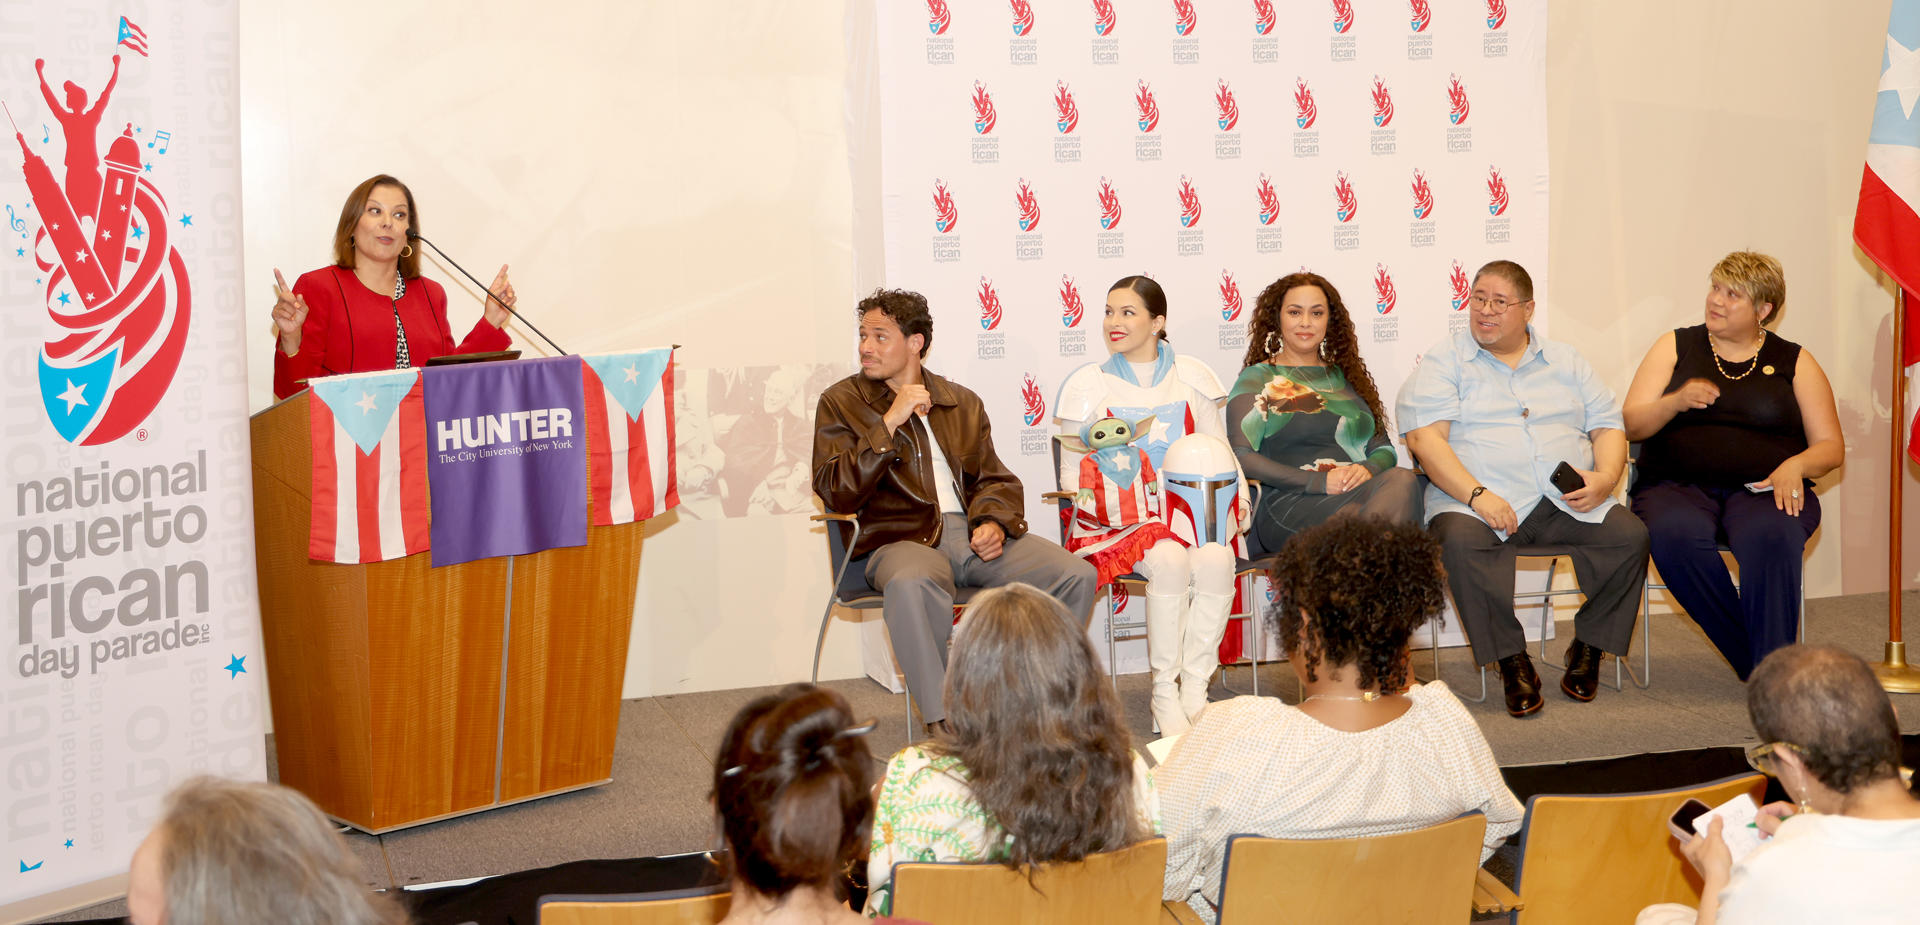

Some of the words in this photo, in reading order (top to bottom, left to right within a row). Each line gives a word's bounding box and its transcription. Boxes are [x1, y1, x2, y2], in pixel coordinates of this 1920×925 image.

[1331, 48, 1356, 58] rican
[1408, 47, 1432, 56] rican
[1484, 44, 1508, 54] rican
[927, 50, 954, 61] rican
[1010, 51, 1037, 62] rican
[1092, 51, 1118, 61] rican
[1173, 51, 1199, 61] rican
[1253, 50, 1278, 60] rican
[197, 30, 234, 168] rican
[1294, 143, 1319, 154] rican
[1371, 142, 1396, 152] rican
[1447, 139, 1471, 149] rican
[972, 150, 999, 160] rican
[1054, 149, 1081, 159] rican
[1136, 147, 1161, 157] rican
[1215, 146, 1241, 156] rican
[1411, 234, 1435, 243] rican
[1486, 230, 1510, 240] rican
[1178, 242, 1203, 252] rican
[1256, 240, 1282, 250] rican
[1334, 237, 1359, 247] rican
[933, 248, 960, 258] rican
[1016, 247, 1043, 257] rican
[1098, 244, 1124, 255] rican
[204, 190, 246, 385] puerto
[1373, 329, 1398, 339] rican
[1219, 336, 1244, 346] rican
[978, 345, 1005, 356] rican
[1060, 343, 1086, 353] rican
[436, 407, 573, 452] HUNTER
[1021, 441, 1047, 451] rican
[438, 452, 456, 464] The
[458, 450, 477, 463] City
[479, 445, 523, 460] University
[525, 444, 533, 453] of
[532, 442, 550, 452] New
[552, 439, 573, 450] York
[17, 449, 207, 517] national
[207, 407, 251, 638] national
[17, 504, 208, 586] puerto
[18, 559, 209, 645] rican
[19, 643, 79, 679] day
[91, 619, 200, 674] parade
[199, 622, 210, 644] inc
[183, 656, 209, 772] ational
[56, 730, 77, 831] national
[87, 791, 105, 851] erto
